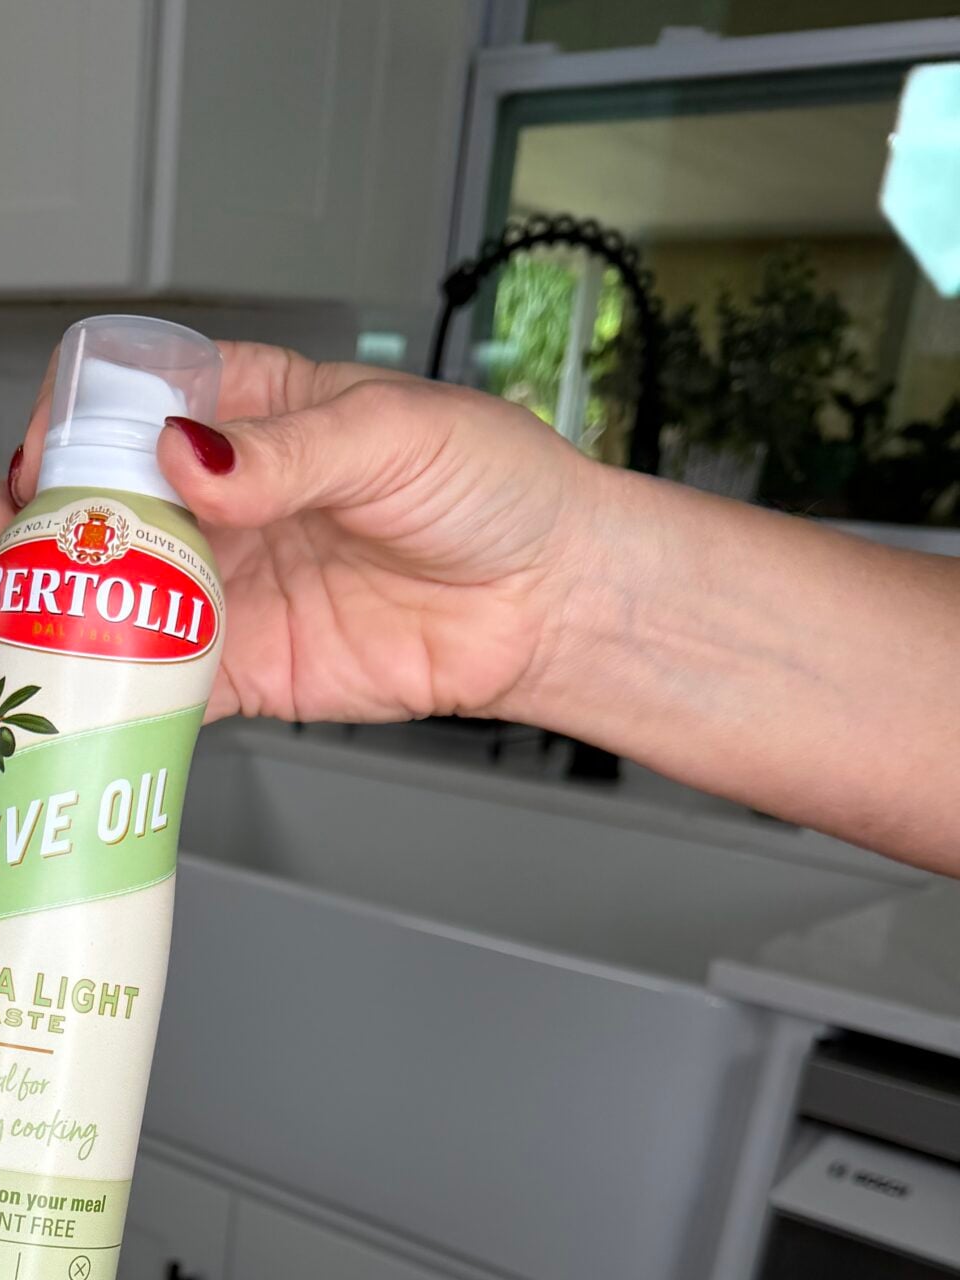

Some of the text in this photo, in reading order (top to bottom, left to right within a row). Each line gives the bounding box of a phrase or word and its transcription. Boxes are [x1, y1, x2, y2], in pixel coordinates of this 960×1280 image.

[136, 529, 175, 552] OLIVE
[178, 548, 197, 568] OIL
[97, 768, 168, 845] OIL
[33, 972, 139, 1019] LIGHT
[17, 1067, 50, 1101] for
[11, 1109, 98, 1161] cooking
[27, 1193, 67, 1212] your
[71, 1195, 106, 1213] meal
[30, 1216, 76, 1238] FREE
